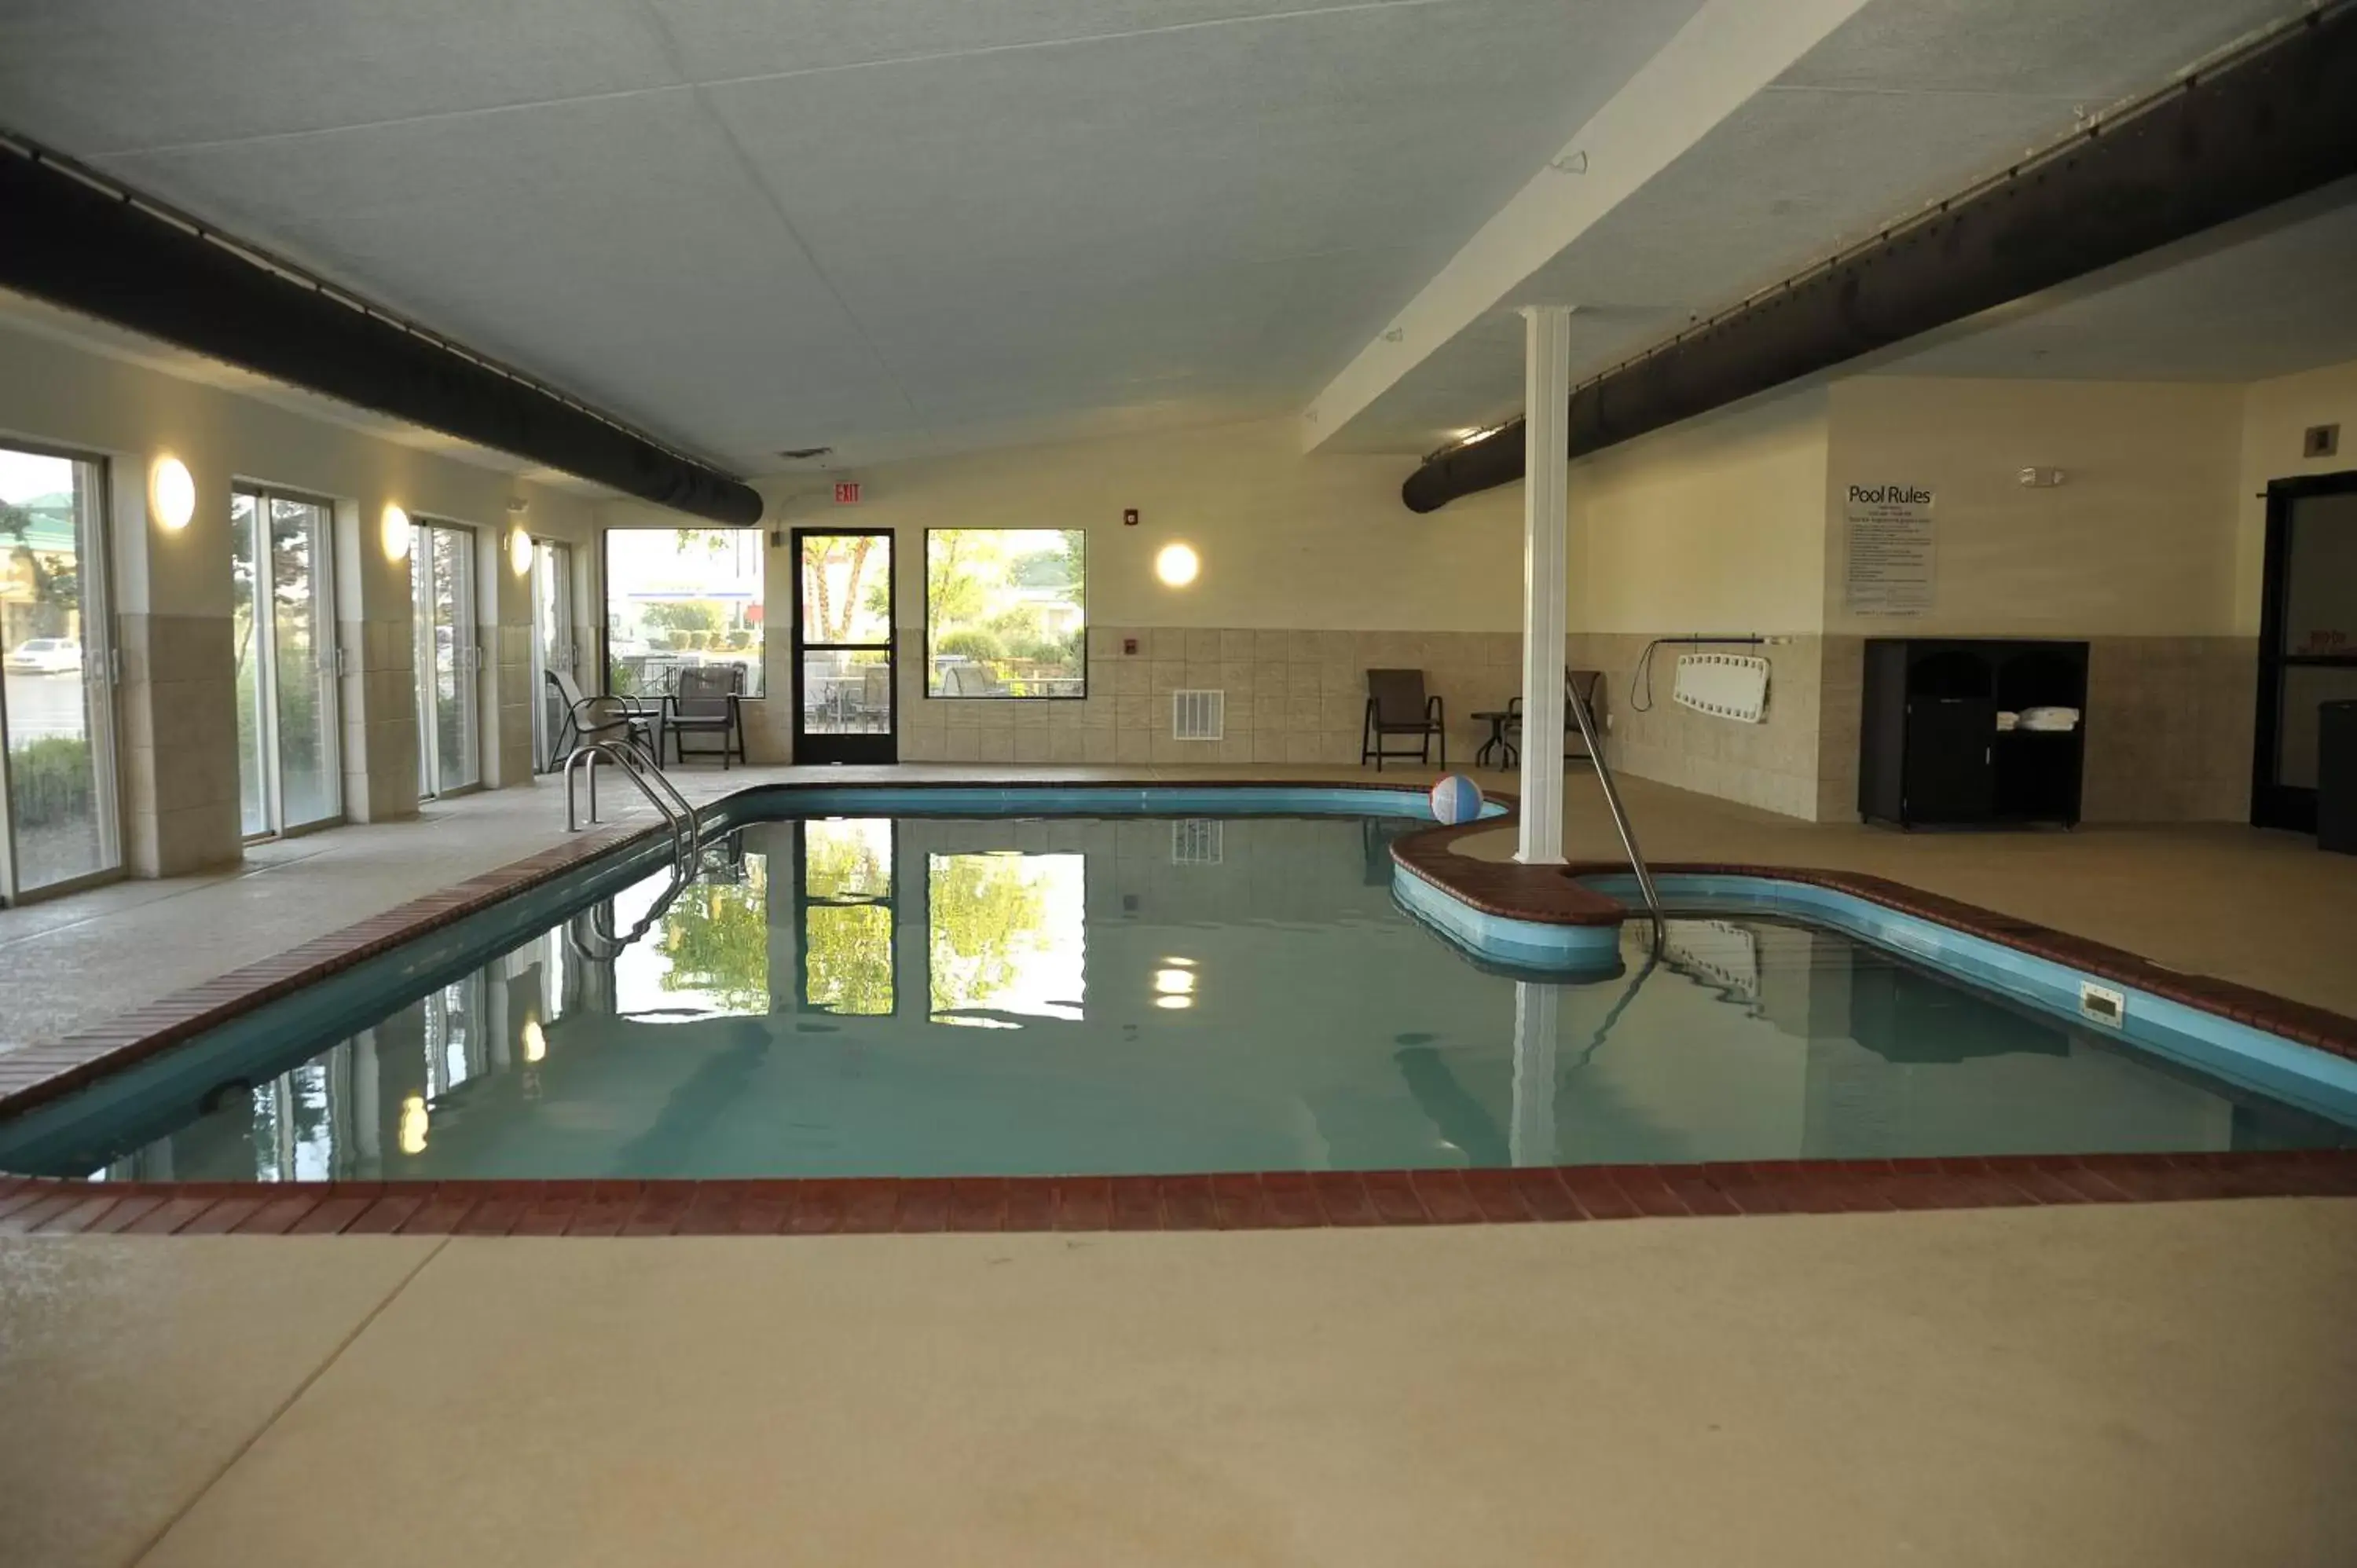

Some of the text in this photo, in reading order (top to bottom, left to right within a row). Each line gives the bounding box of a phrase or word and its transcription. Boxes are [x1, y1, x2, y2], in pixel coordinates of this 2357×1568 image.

[835, 483, 860, 503] EXIT
[1849, 484, 1930, 504] Pool Rules
